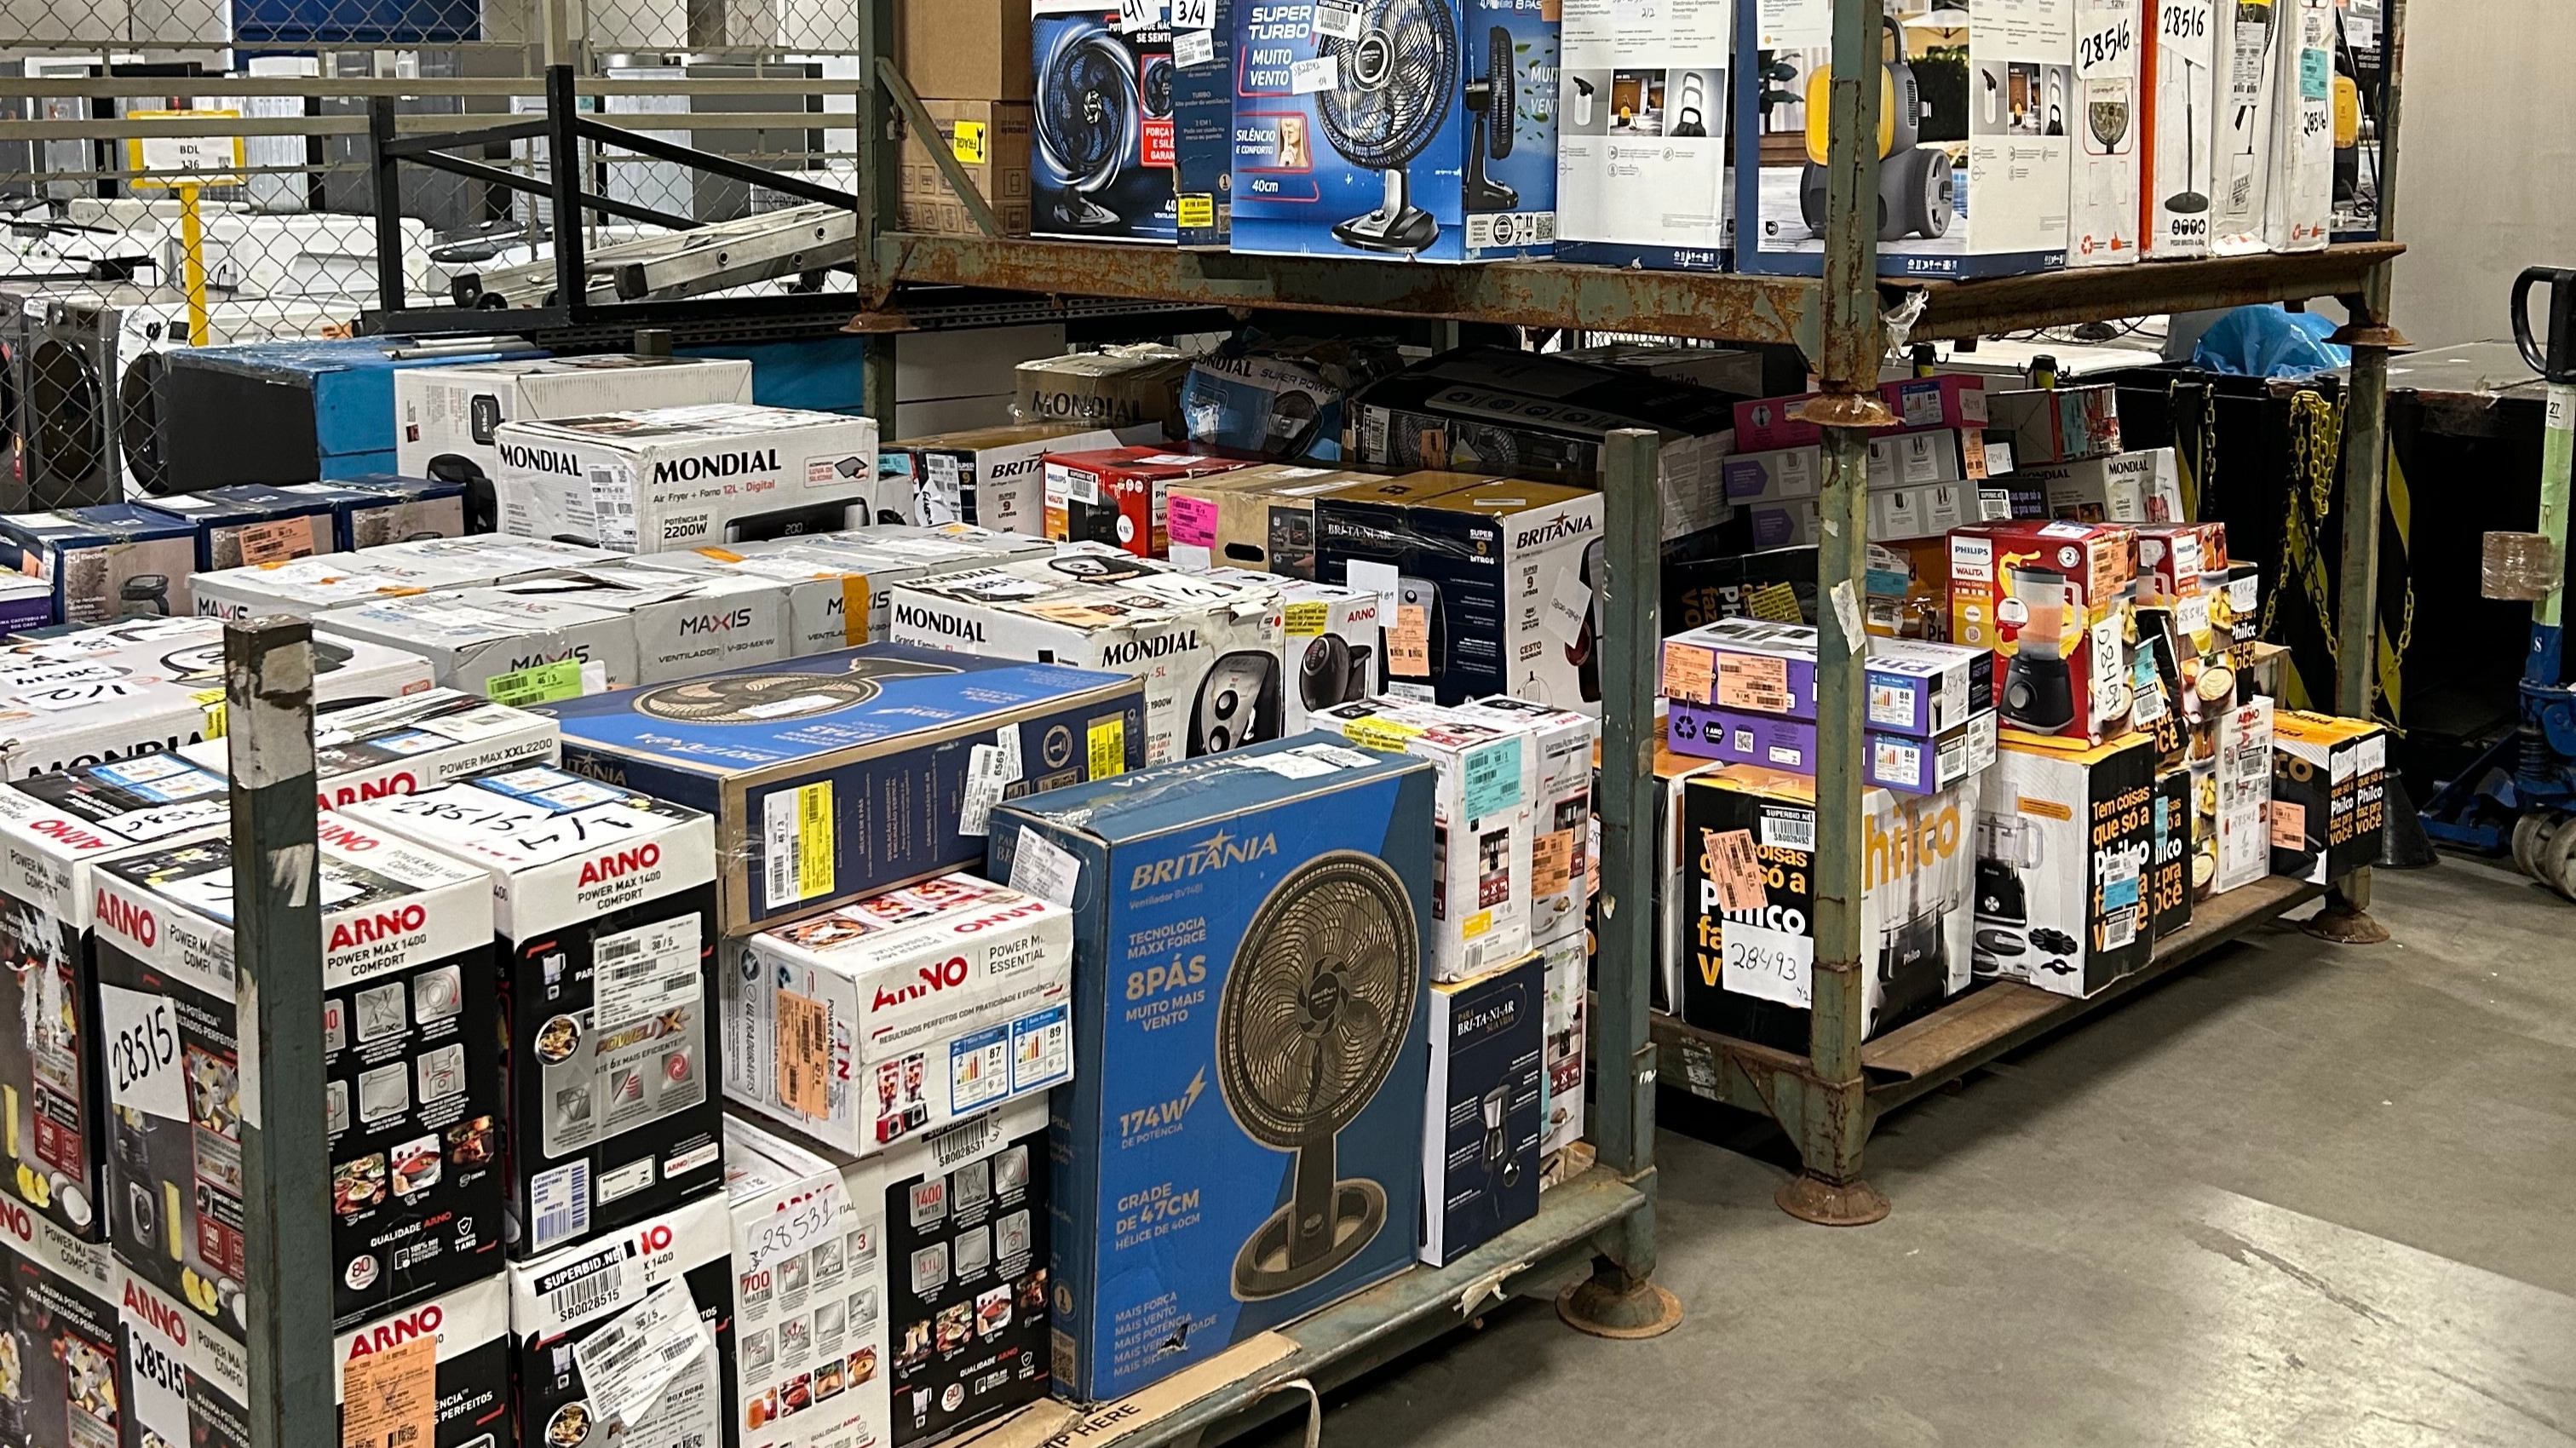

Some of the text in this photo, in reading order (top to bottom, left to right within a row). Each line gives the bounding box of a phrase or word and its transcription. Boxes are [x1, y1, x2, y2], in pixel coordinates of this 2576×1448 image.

[1251, 5, 1312, 24] SUPER
[2164, 5, 2206, 38] 28516
[1136, 32, 1147, 43] SE
[1248, 24, 1310, 40] TURBO
[2079, 18, 2130, 70] 28516
[1251, 48, 1292, 66] MUITO
[1250, 70, 1289, 86] VENTO
[1530, 66, 1559, 83] MUIT
[1530, 98, 1559, 114] VENT
[1146, 127, 1169, 138] FORÇA
[1235, 128, 1276, 142] SILÊNCIO
[180, 145, 200, 154] BDL
[1240, 145, 1274, 154] CONFORTO
[1251, 180, 1279, 192] 40cm
[500, 442, 583, 477] MONDIAL
[653, 448, 782, 486] MONDIAL
[2108, 457, 2149, 475] MONDIAL
[668, 479, 775, 503] Fryer 12L Digital
[664, 523, 708, 539] 2200W
[1955, 545, 1989, 556] PHILIPS
[1955, 566, 1985, 577] WALITA
[197, 596, 249, 621] MAXIS
[680, 607, 751, 636] MAXIS
[1347, 606, 1376, 623] ARNO
[894, 603, 986, 643] MONDIAL
[658, 646, 720, 664] VENTILADOR
[1101, 629, 1199, 668] MONDIAL
[1520, 641, 1543, 655] CESTO
[1154, 666, 1166, 678] 5L
[439, 750, 503, 776] POWER MAX
[993, 751, 1006, 777] 6569
[2092, 786, 2151, 821] Tem coisas
[2331, 796, 2355, 817] Philco
[2356, 785, 2383, 806] Philco
[2355, 801, 2383, 819] faz pra
[2093, 810, 2150, 848] que só a
[2355, 812, 2383, 835] você
[1864, 798, 1961, 892] hilco
[9, 849, 37, 871] POWER
[578, 842, 661, 888] ARNO
[2161, 862, 2182, 884] pra
[577, 871, 662, 905] POWER MAX 1400
[1790, 874, 1807, 894] a
[596, 888, 644, 910] COMFORT
[1129, 891, 1174, 911] Ventilador
[95, 887, 157, 949] ARNO
[327, 903, 428, 954] ARNO
[1129, 916, 1207, 946] TECNOLOGIA
[170, 923, 198, 950] POWER
[989, 939, 1029, 960] POWER
[1128, 929, 1207, 960] MAXX FORCE
[327, 933, 428, 971] POWER MAX 1400
[351, 951, 407, 977] COMFORT
[989, 948, 1046, 975] ESSENTIAL
[1730, 942, 1797, 981] 28493
[827, 998, 836, 1036] POWER
[878, 1025, 923, 1045] RESULTADOS
[923, 1014, 957, 1034] PERFEITOS
[958, 1009, 975, 1022] COM
[975, 993, 1016, 1017] PRATICIDADE
[1125, 990, 1205, 1022] MUITO MAIS
[1049, 1026, 1062, 1039] 89
[1141, 1008, 1189, 1032] VENTO
[112, 1003, 174, 1094] 28515
[988, 1046, 1002, 1058] 87
[1118, 1098, 1188, 1139] 174W
[1120, 1123, 1184, 1150] DE POTÊNCIA
[938, 1140, 986, 1168] SB0028531
[914, 1183, 942, 1208] 1400
[1118, 1182, 1173, 1213] GRADE
[917, 1202, 940, 1217] WATTS
[1116, 1188, 1200, 1235] DE 47CM
[44, 1224, 74, 1251] POWER
[371, 1210, 452, 1247] QUALIDADE ARNO
[857, 1233, 866, 1250] 3
[1114, 1213, 1201, 1251] HÉLICE DE 40CM
[351, 1256, 371, 1275] 80
[652, 1251, 675, 1271] 1400
[741, 1270, 770, 1295] 700
[559, 1289, 621, 1323] SB0028515
[744, 1290, 770, 1305] WATTS
[1114, 1291, 1178, 1324] MAIS FORÇA
[124, 1277, 187, 1347] ARNO
[1114, 1305, 1177, 1336] MAIS VENTO
[198, 1329, 227, 1359] POWER
[348, 1304, 444, 1362] ARNO
[1113, 1312, 1193, 1351] MAIS POTÊNCIA
[131, 1330, 186, 1399] 28515
[959, 1347, 1018, 1377] QUALIDADE ARNO
[1113, 1347, 1141, 1365] MAIS
[1113, 1361, 1141, 1378] MAIS
[440, 1391, 494, 1422] PERFEITOS
[810, 1414, 861, 1442] QUALIDADE ARNO
[1073, 1403, 1141, 1439] HERE
